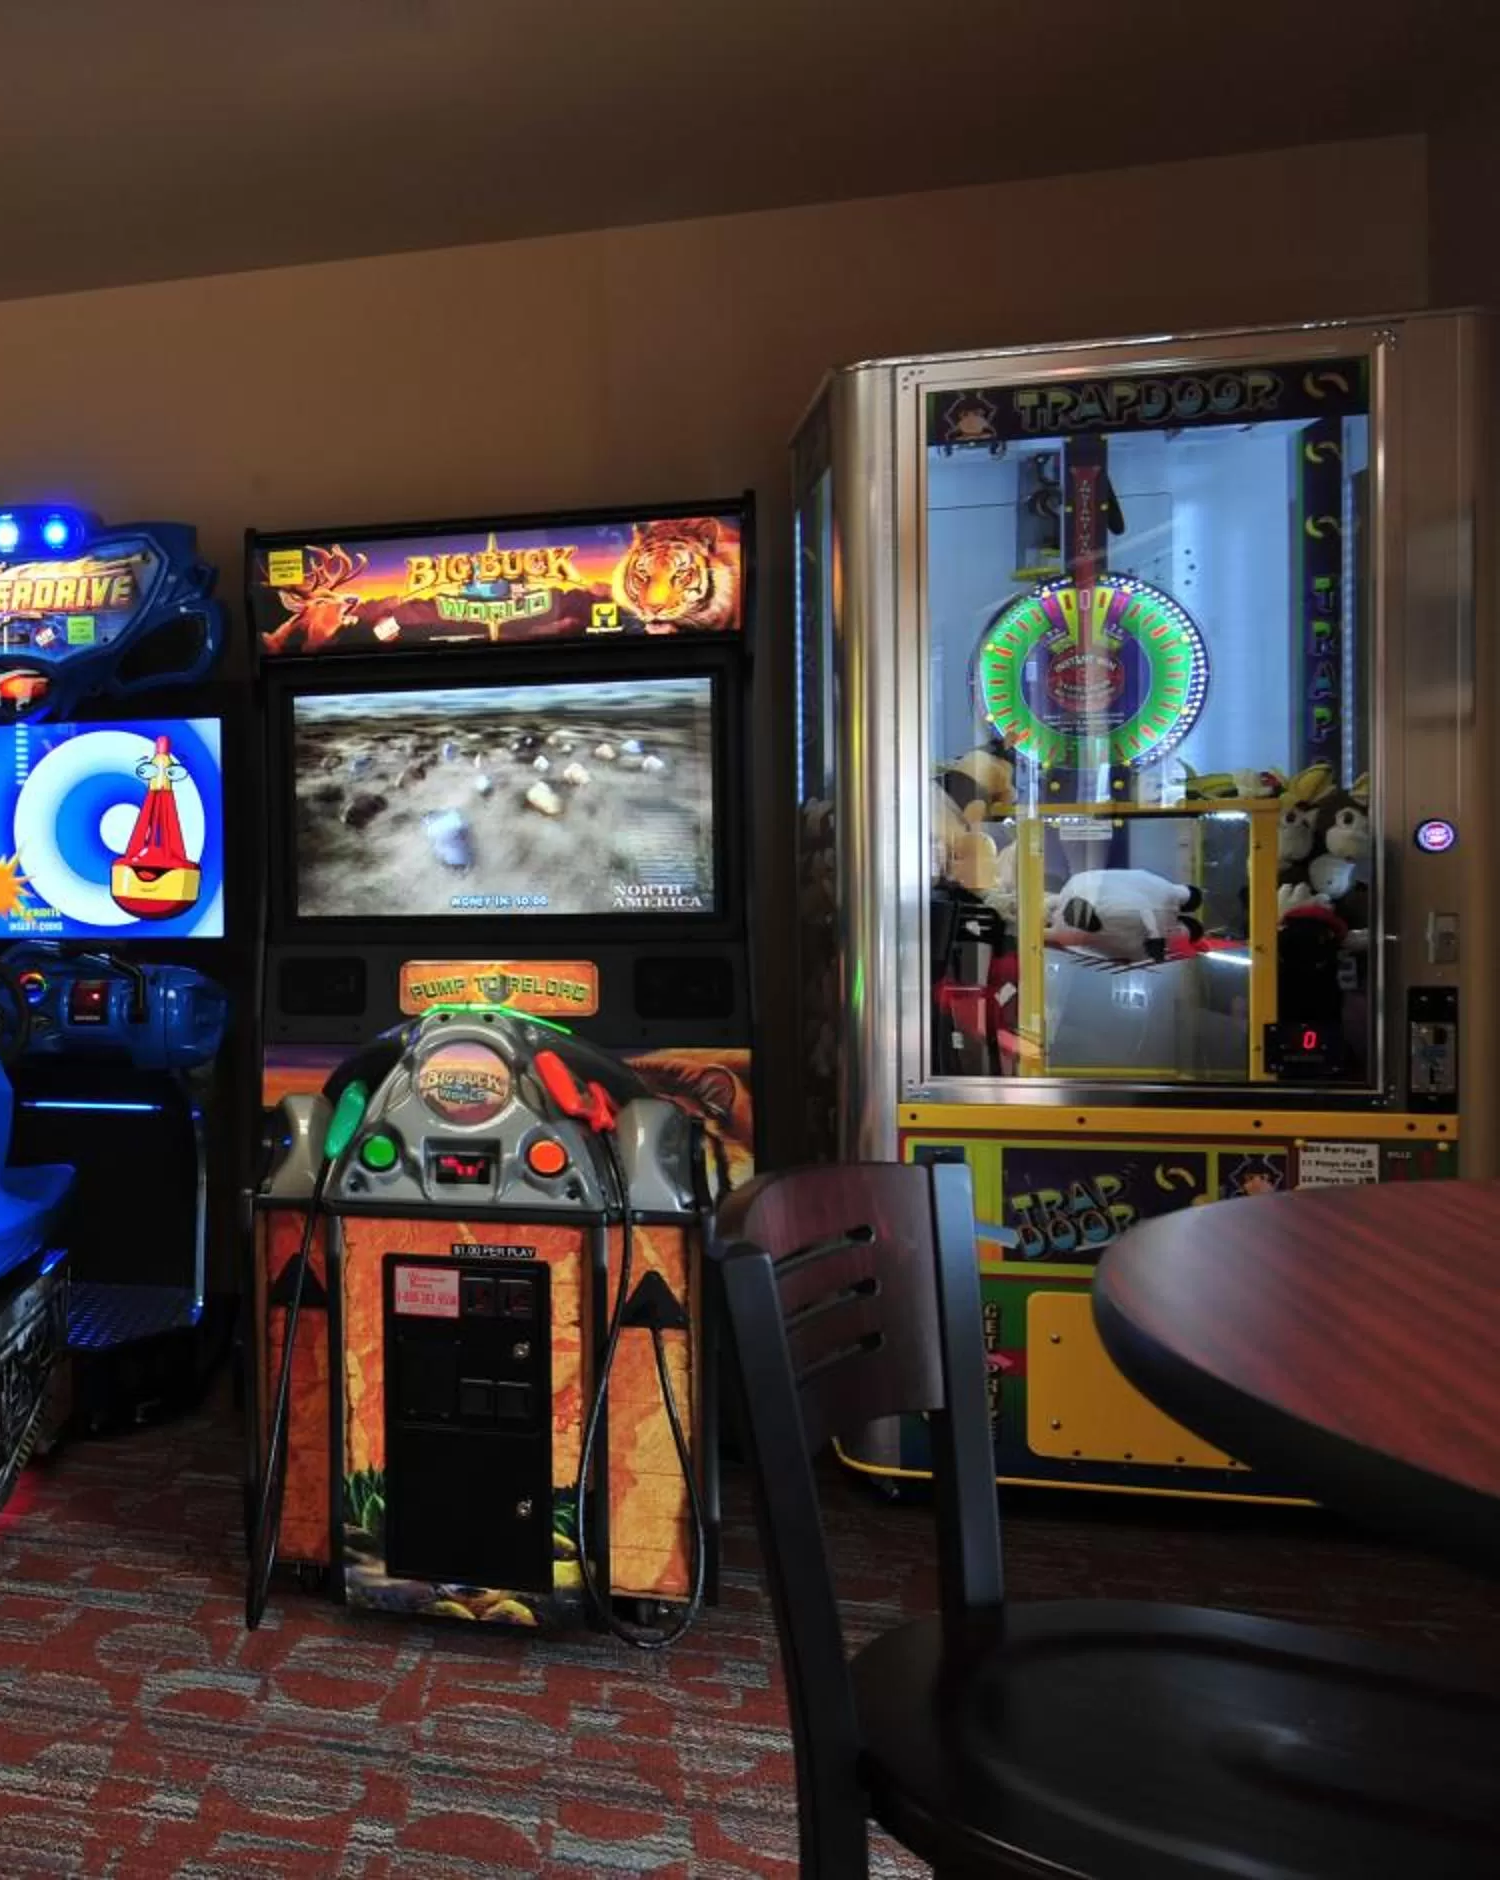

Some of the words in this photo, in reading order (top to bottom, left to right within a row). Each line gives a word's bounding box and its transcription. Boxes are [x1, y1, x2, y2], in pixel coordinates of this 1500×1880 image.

[1016, 372, 1283, 431] TRAPDOOR
[405, 553, 471, 594] BIG
[479, 545, 583, 583] BUCK
[441, 590, 549, 620] WORLD
[612, 896, 703, 908] AMERICA
[614, 884, 681, 896] NORTH
[410, 976, 467, 1001] PUMP
[474, 974, 500, 993] TO
[506, 975, 592, 1002] RELOAD
[1303, 1031, 1317, 1049] 0
[1011, 1175, 1122, 1228] TRAP
[1018, 1203, 1137, 1259] DOOR
[453, 1244, 481, 1255] $1.00
[483, 1245, 506, 1257] PER
[507, 1246, 535, 1258] PLAY
